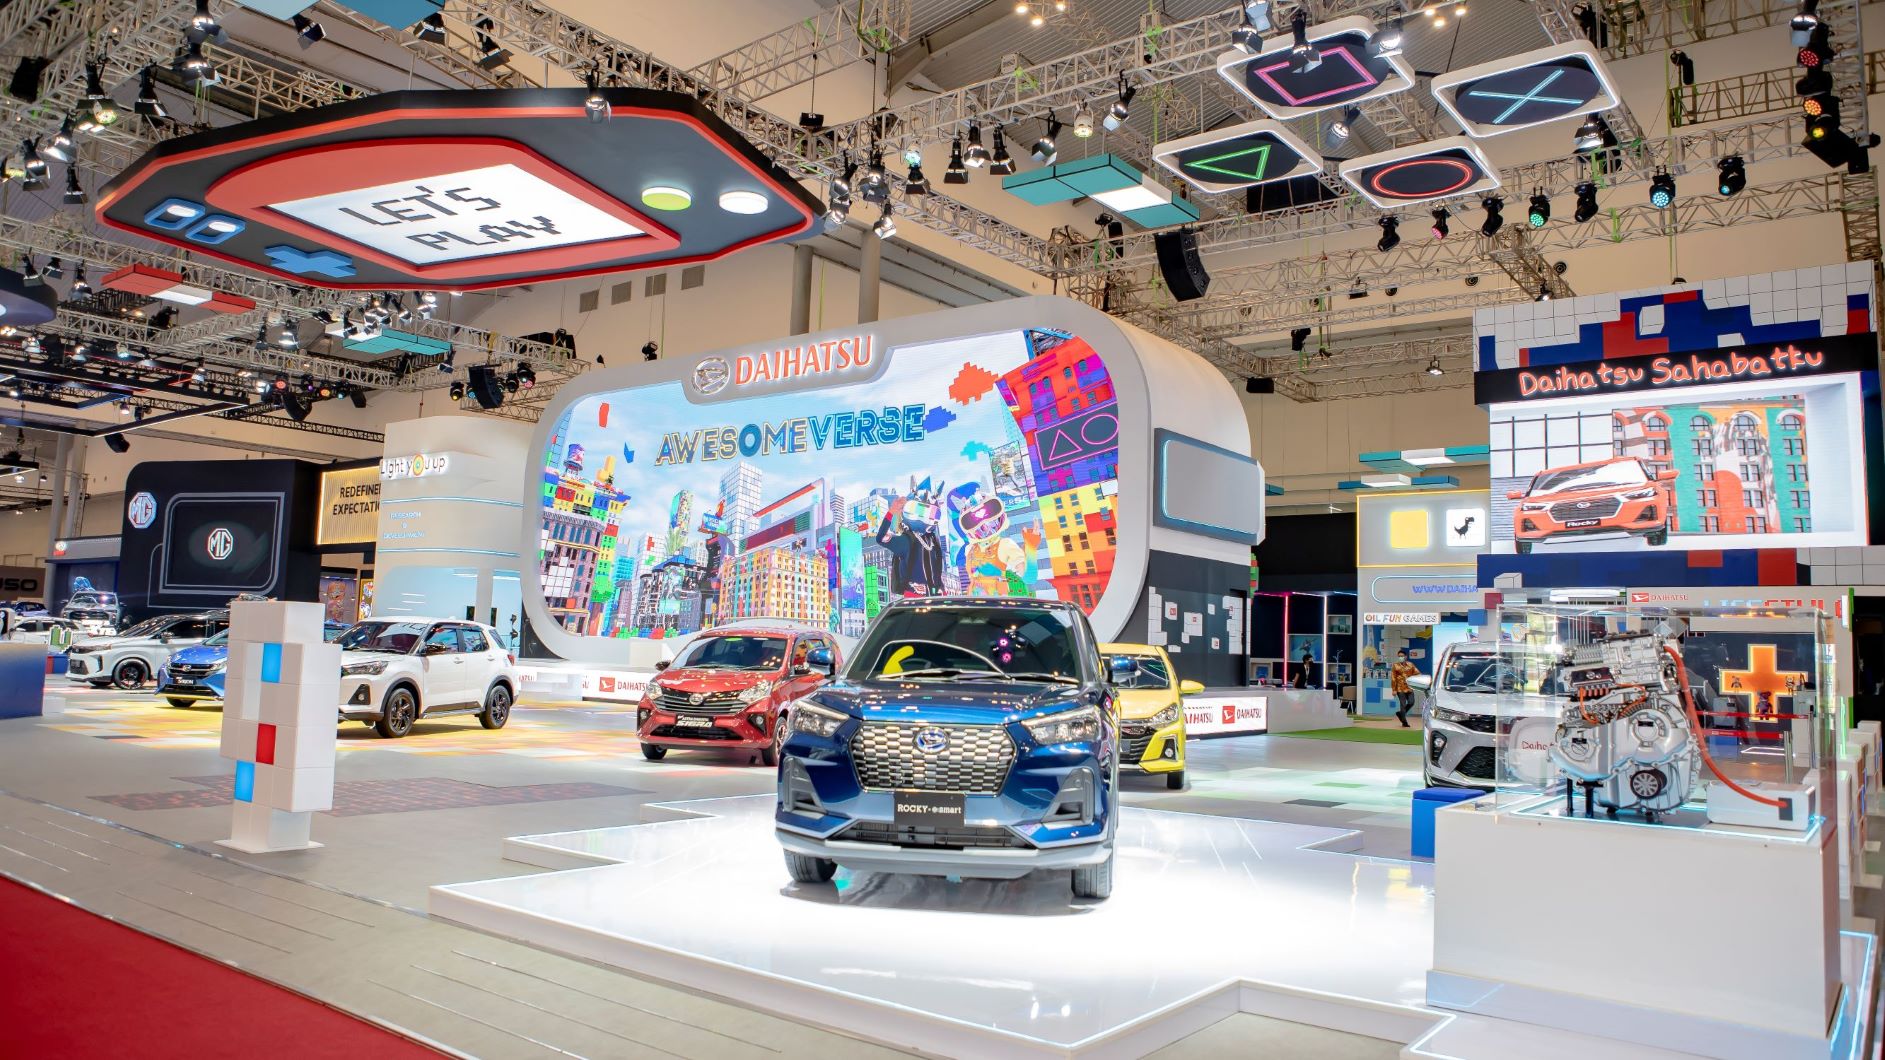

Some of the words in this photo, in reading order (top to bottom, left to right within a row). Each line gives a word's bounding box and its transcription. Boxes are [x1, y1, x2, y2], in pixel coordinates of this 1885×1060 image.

[338, 185, 501, 226] LET'S
[405, 215, 562, 251] PLAY
[735, 335, 872, 385] DAIHATSU
[1518, 361, 1644, 396] Daihatsu
[1651, 344, 1823, 384] Sahabatku
[654, 403, 925, 466] AWESOMEVERSE
[432, 457, 446, 472] up
[333, 502, 379, 515] EXPECTATI
[0, 578, 37, 591] SO
[1651, 593, 1688, 601] DAIHATSU
[1365, 614, 1380, 622] OIL
[1382, 614, 1402, 622] FUN
[1403, 614, 1437, 623] GAMES
[1236, 708, 1262, 719] DAIHATSU
